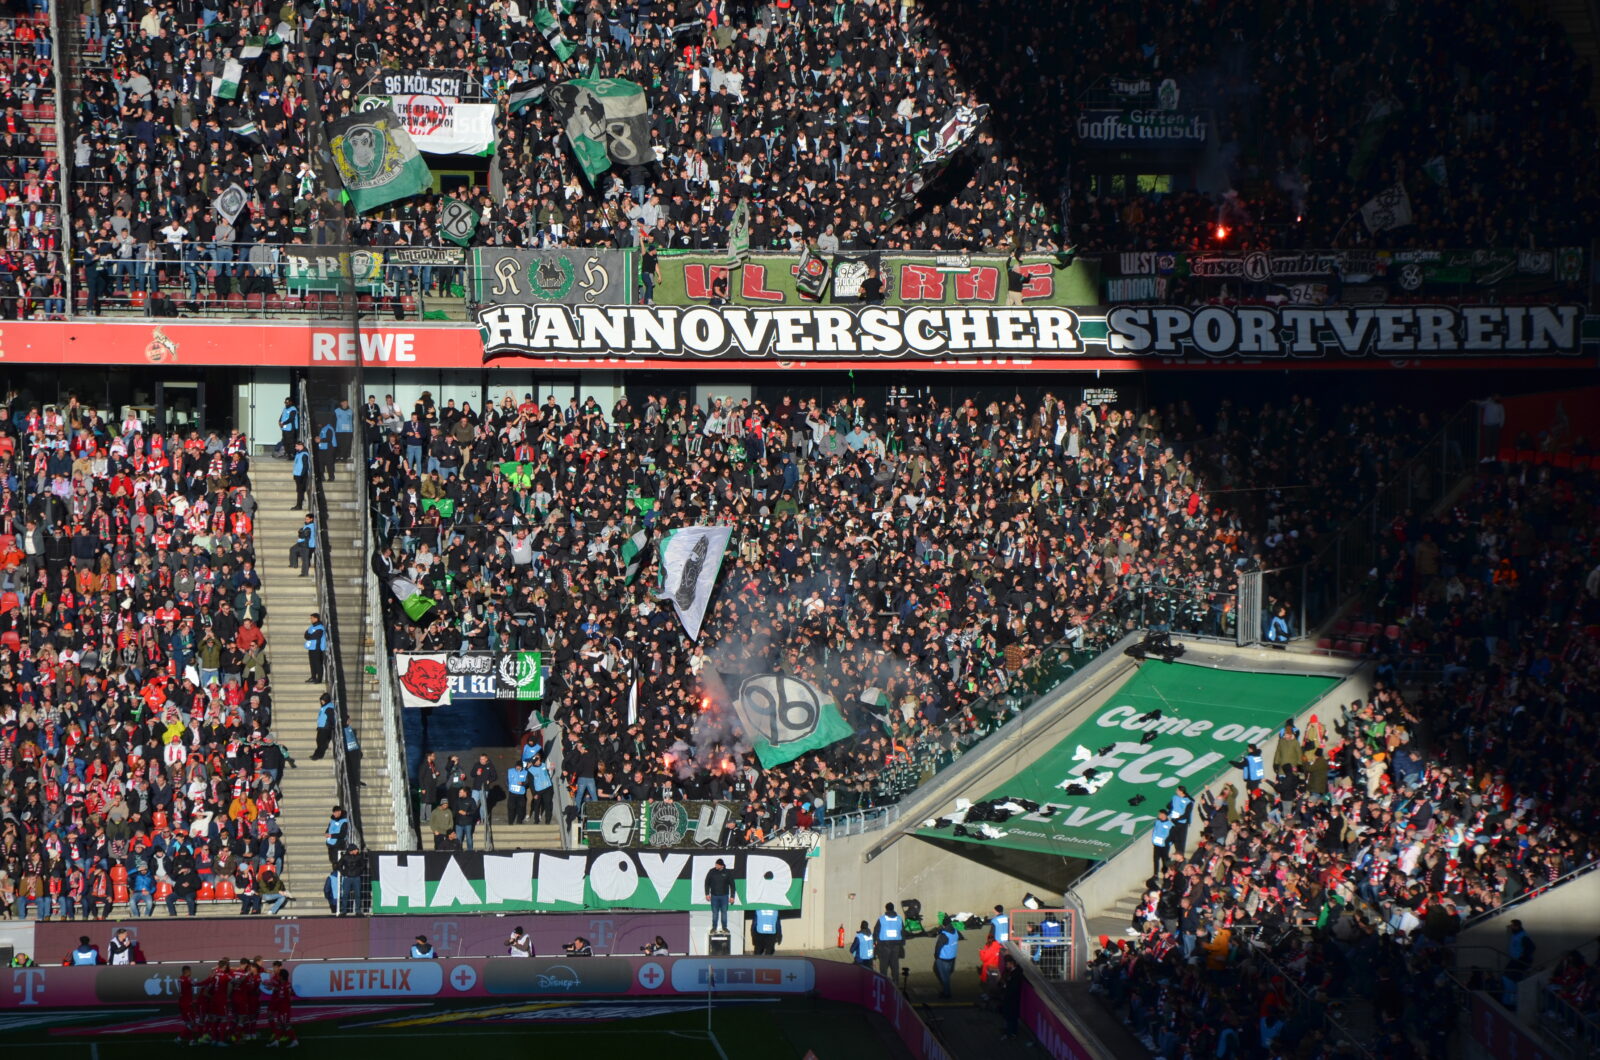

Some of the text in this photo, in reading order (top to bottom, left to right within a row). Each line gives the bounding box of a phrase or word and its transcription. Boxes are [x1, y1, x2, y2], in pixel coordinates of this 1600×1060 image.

[385, 71, 460, 96] 96 KÖLSCH
[398, 103, 412, 113] THE
[446, 203, 470, 236] 96
[1120, 251, 1157, 274] WEST
[482, 305, 1580, 353] HANNOVERSCHER SPORTVEREIN
[312, 333, 417, 361] REWE
[745, 674, 816, 747] 96
[1097, 704, 1213, 737] Come
[378, 851, 792, 907] HANNOVER
[329, 968, 412, 993] NETFLIX
